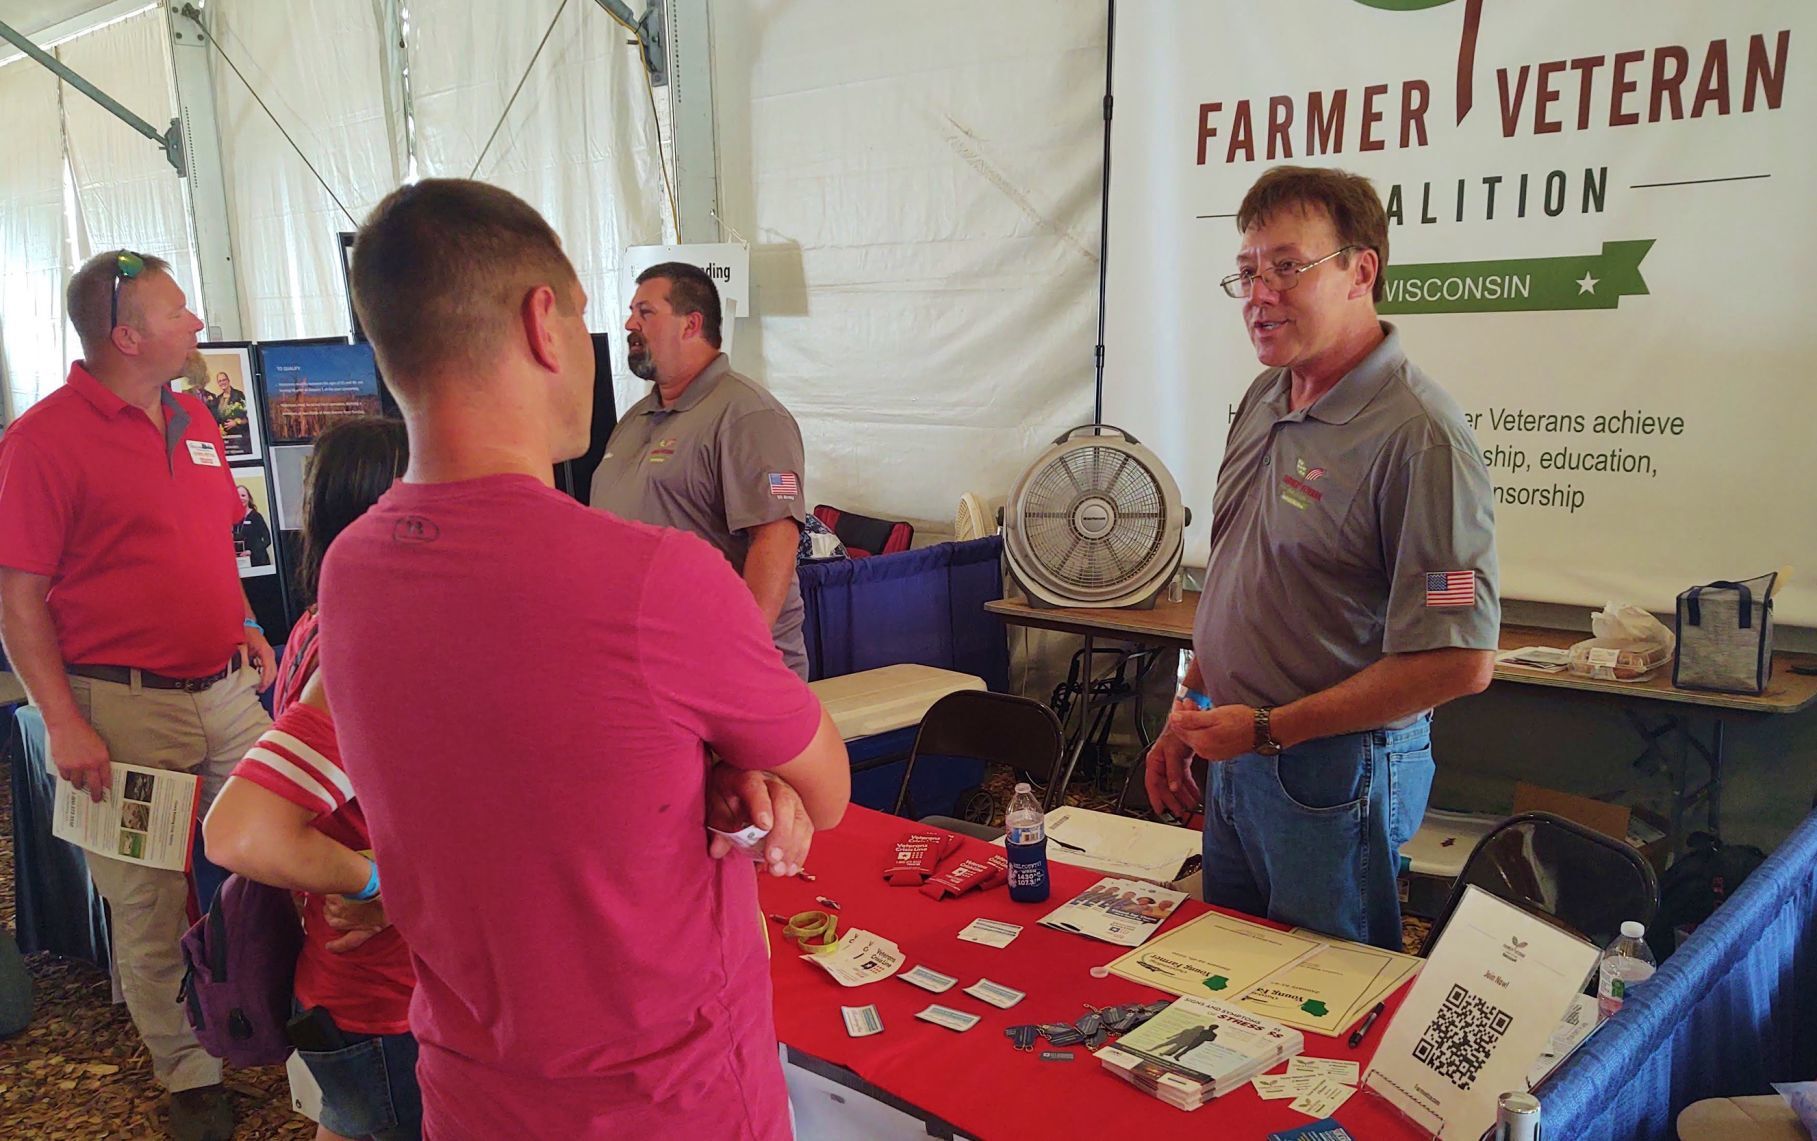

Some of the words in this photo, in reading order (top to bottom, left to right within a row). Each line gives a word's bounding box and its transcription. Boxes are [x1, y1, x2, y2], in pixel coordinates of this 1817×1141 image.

[1196, 79, 1431, 166] FARMER
[1496, 30, 1791, 139] VETERAN
[1387, 167, 1609, 226] ALITION
[1489, 408, 1586, 433] Veterans
[1592, 409, 1685, 436] achieve
[1483, 445, 1531, 474] ship,
[1540, 446, 1658, 478] education,
[1493, 483, 1585, 514] nsorship
[877, 948, 896, 963] Veterans
[1149, 953, 1181, 969] Farmer
[1182, 964, 1212, 977] Young
[1271, 989, 1303, 1002] Young
[1185, 997, 1205, 1007] SIGNS
[1206, 1003, 1221, 1012] AND
[1221, 1008, 1262, 1025] SYMPTOMS
[1217, 1014, 1265, 1032] STRESS
